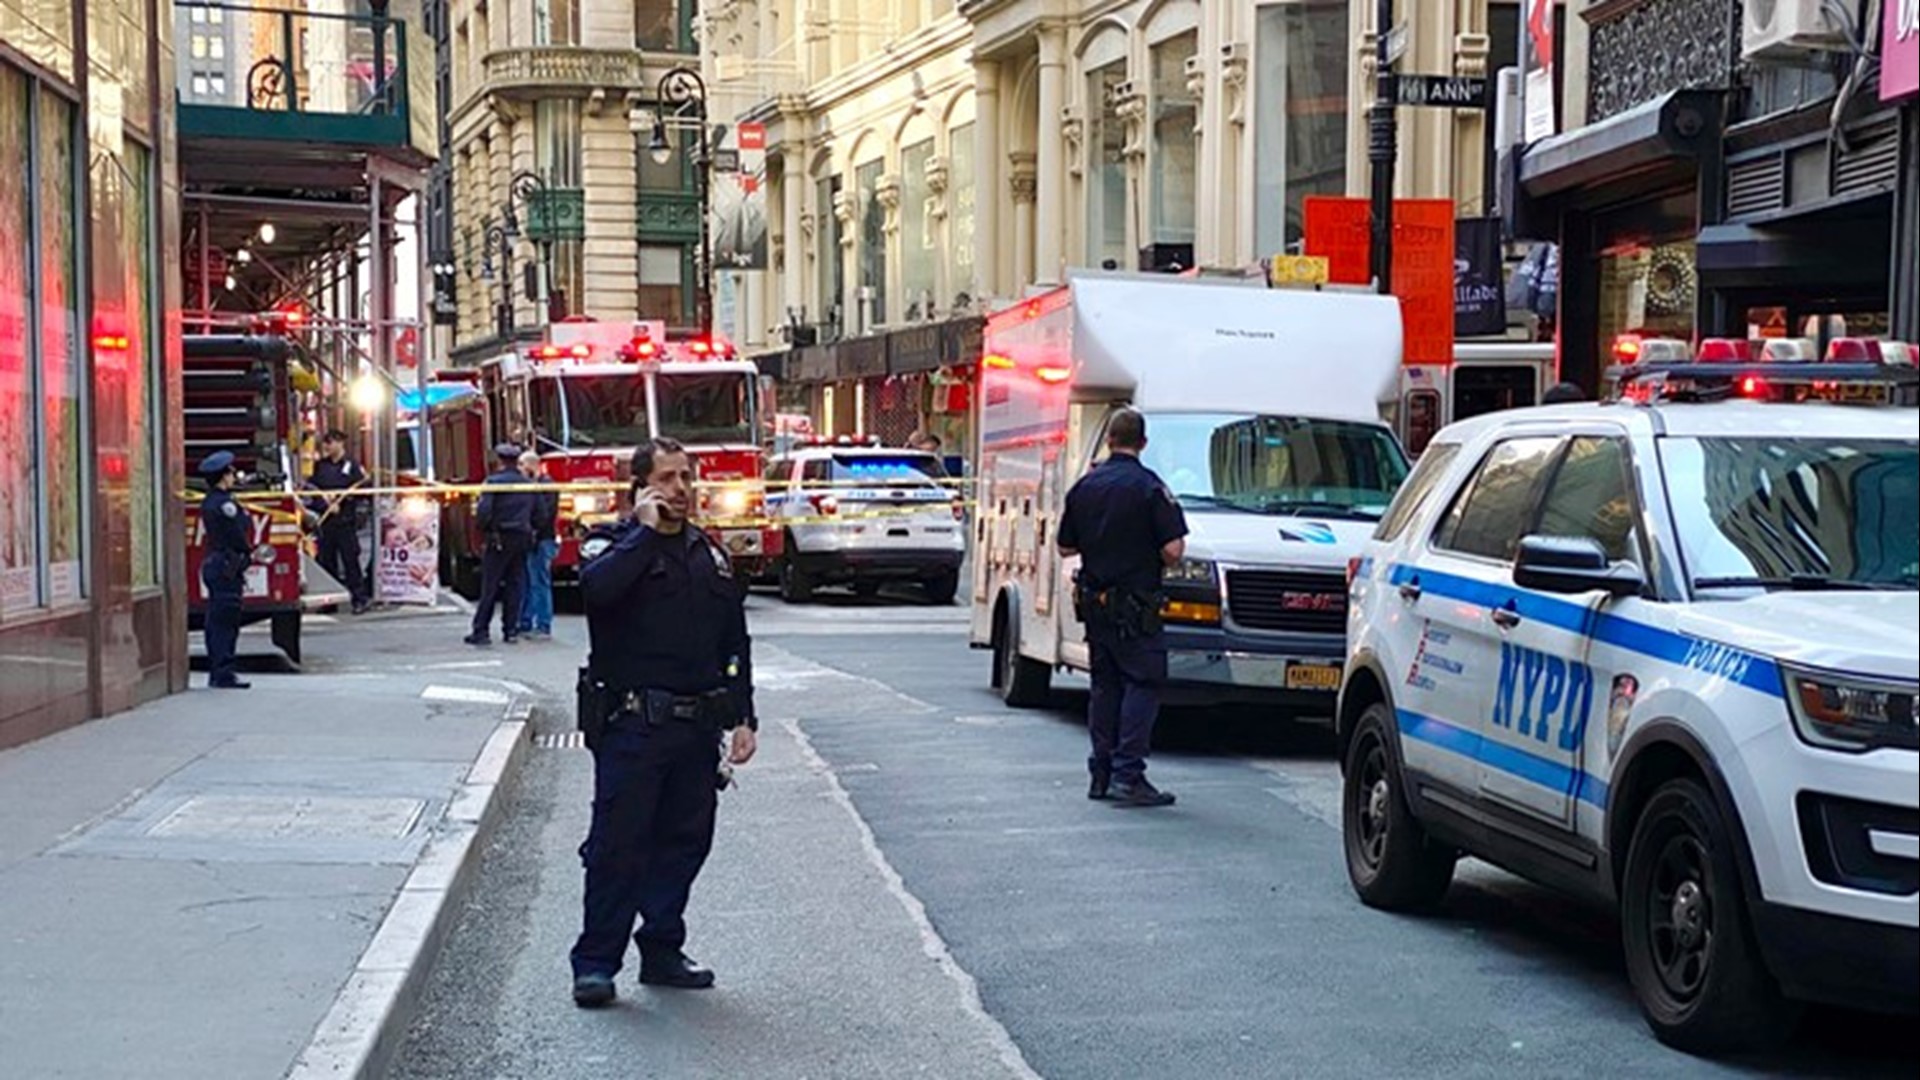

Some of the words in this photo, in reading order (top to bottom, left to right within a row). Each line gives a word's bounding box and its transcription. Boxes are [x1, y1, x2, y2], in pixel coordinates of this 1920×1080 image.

[1430, 82, 1471, 100] ANN
[1685, 638, 1750, 683] POLICE
[1493, 640, 1594, 752] NYPD
